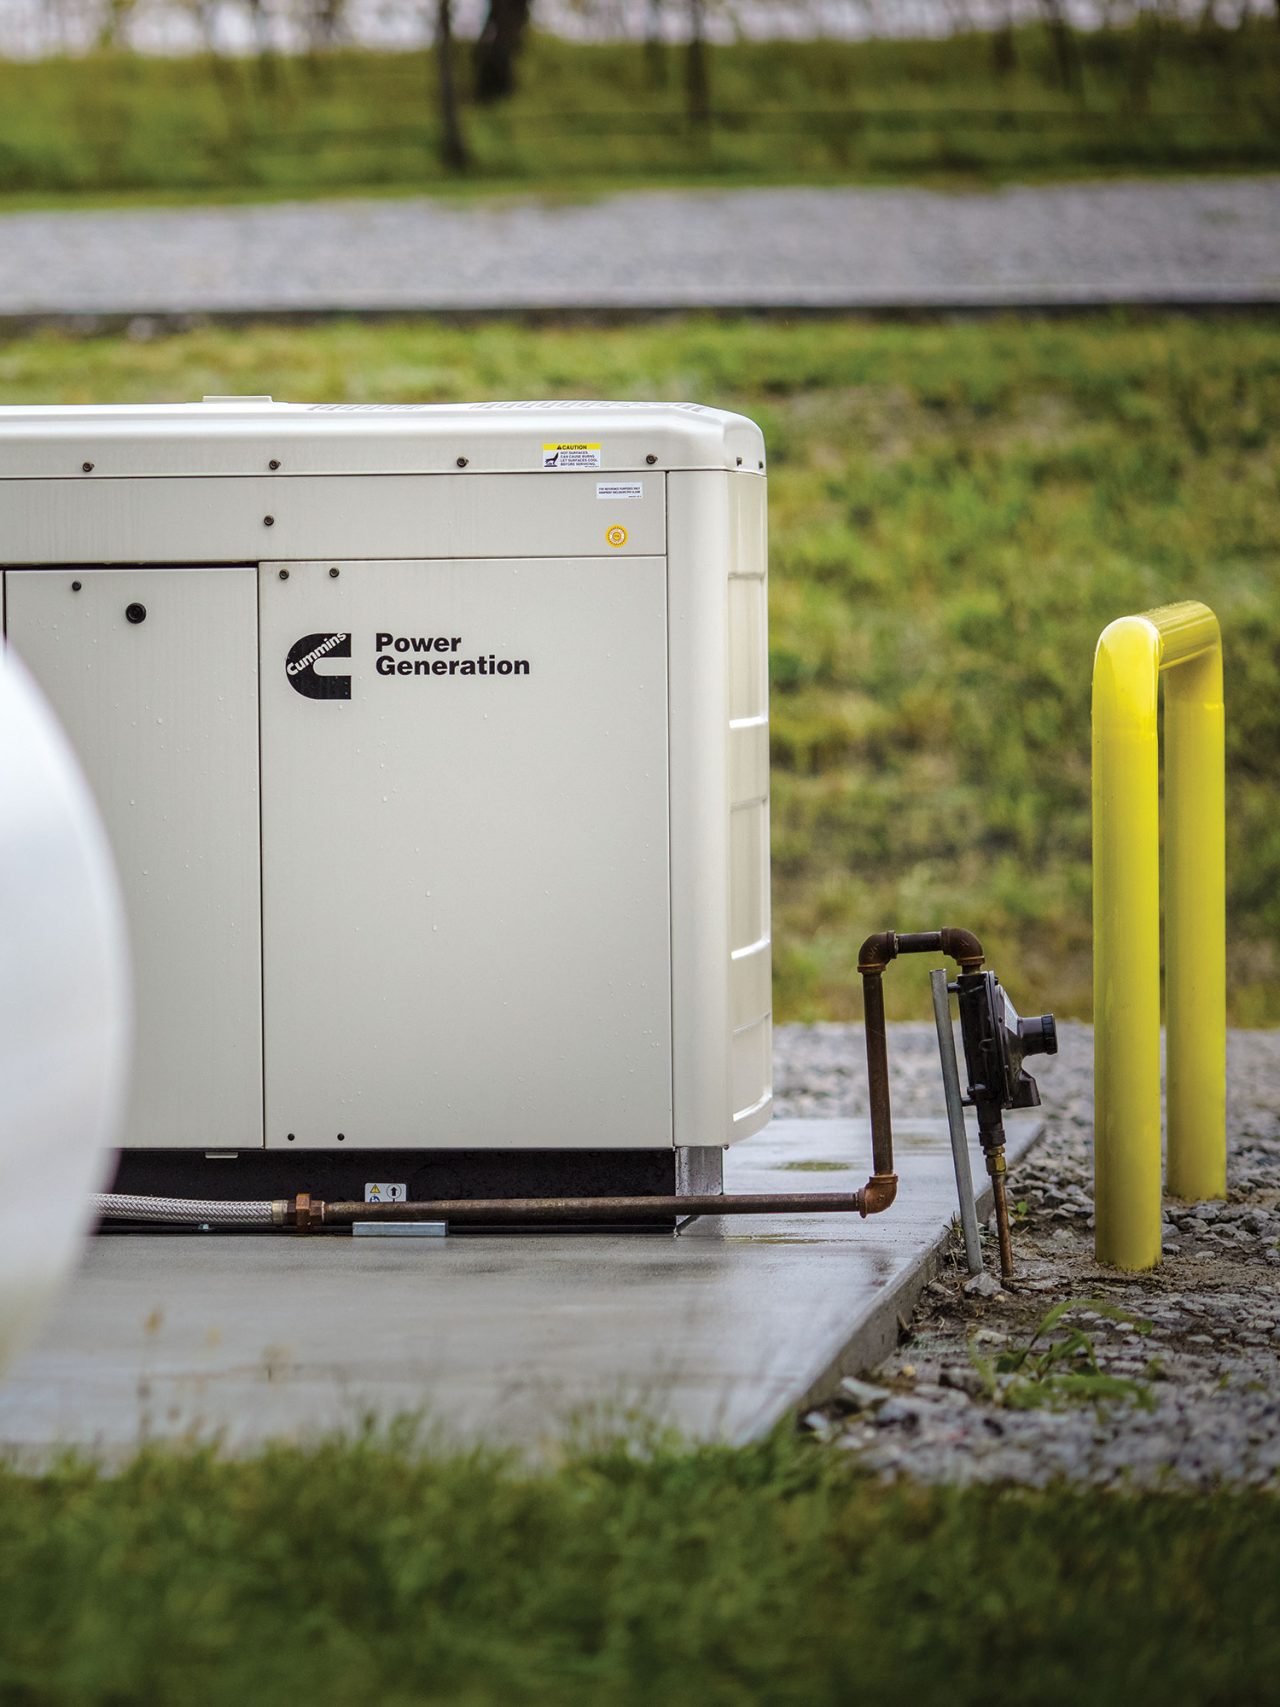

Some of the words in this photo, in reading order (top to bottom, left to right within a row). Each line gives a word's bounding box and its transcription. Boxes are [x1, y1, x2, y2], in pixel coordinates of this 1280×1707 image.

[375, 632, 462, 653] Power
[286, 632, 347, 676] Cummins
[375, 655, 530, 676] Generation
